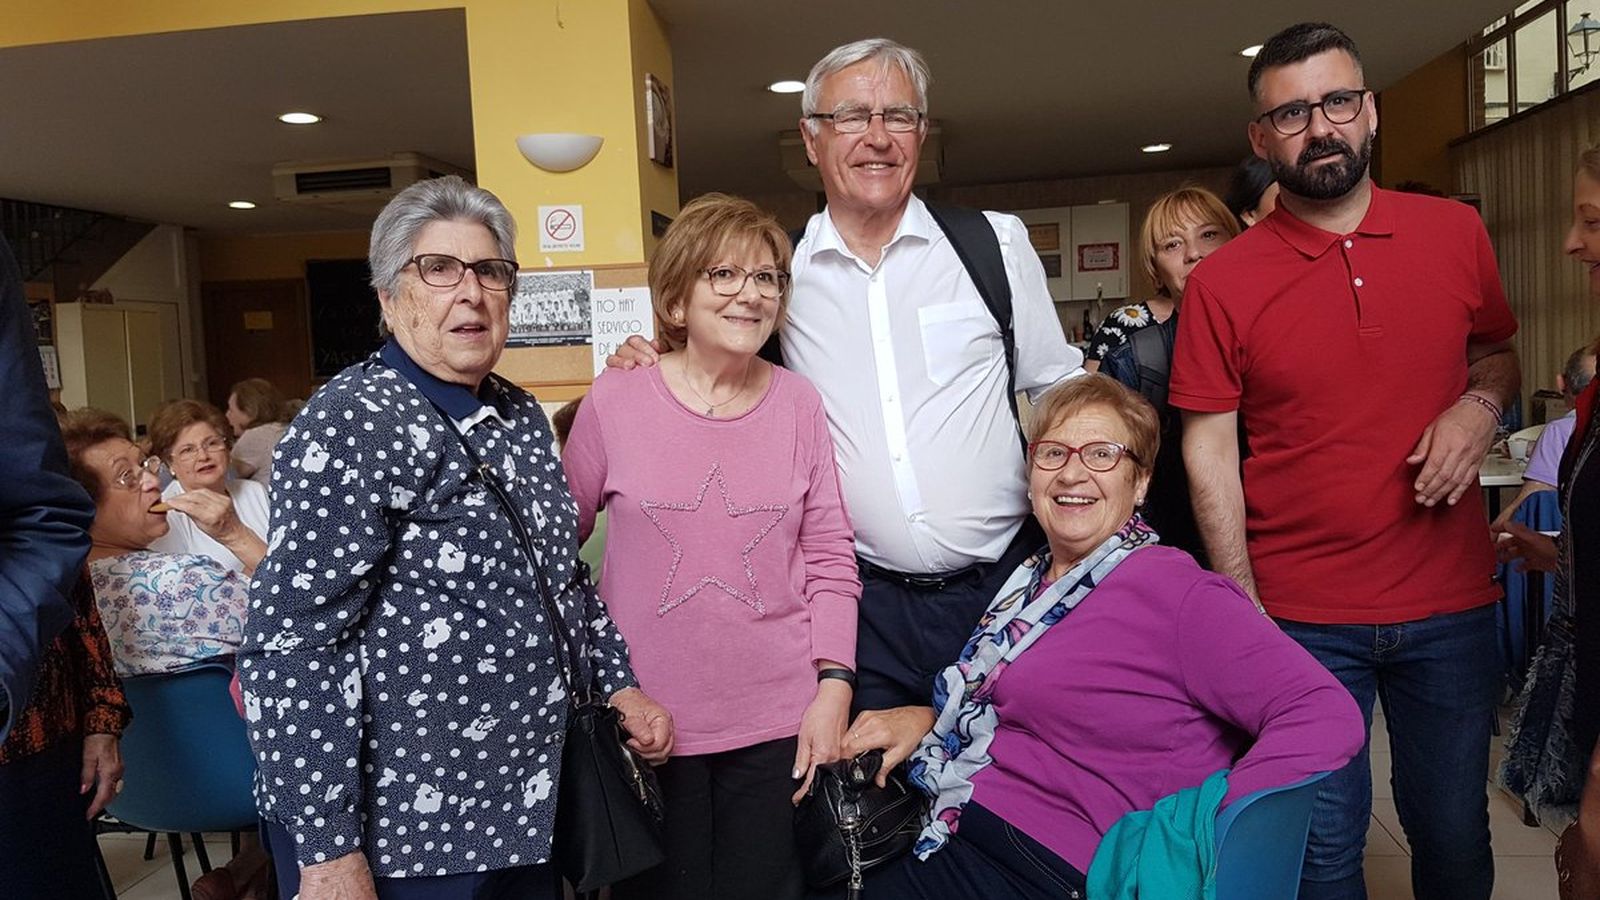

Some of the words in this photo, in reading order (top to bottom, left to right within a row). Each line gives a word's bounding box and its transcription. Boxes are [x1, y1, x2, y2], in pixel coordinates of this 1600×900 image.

[596, 299, 616, 313] NO
[618, 298, 635, 312] HAY
[598, 342, 614, 355] DE
